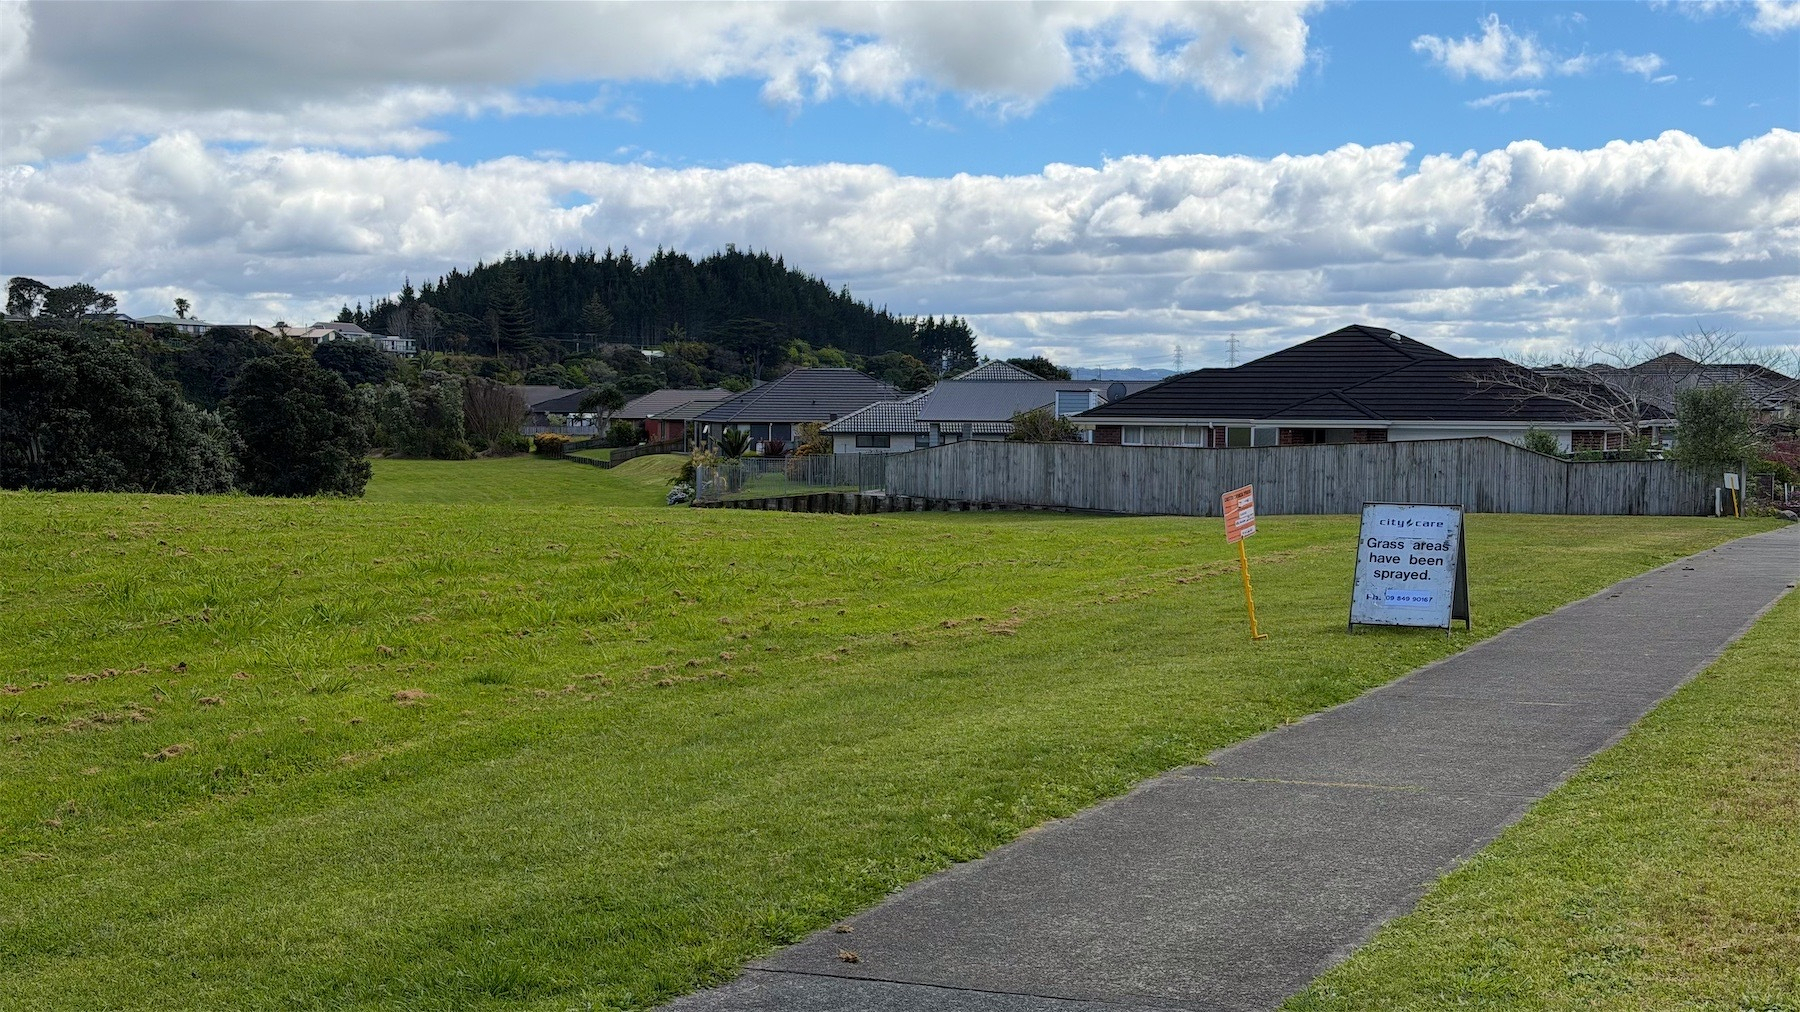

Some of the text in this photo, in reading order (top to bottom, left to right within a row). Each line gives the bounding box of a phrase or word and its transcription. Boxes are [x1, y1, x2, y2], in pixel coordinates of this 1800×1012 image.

[1379, 519, 1405, 528] city
[1367, 537, 1449, 552] Grass areas
[1369, 552, 1443, 566] have been
[1373, 569, 1431, 581] sprayed.
